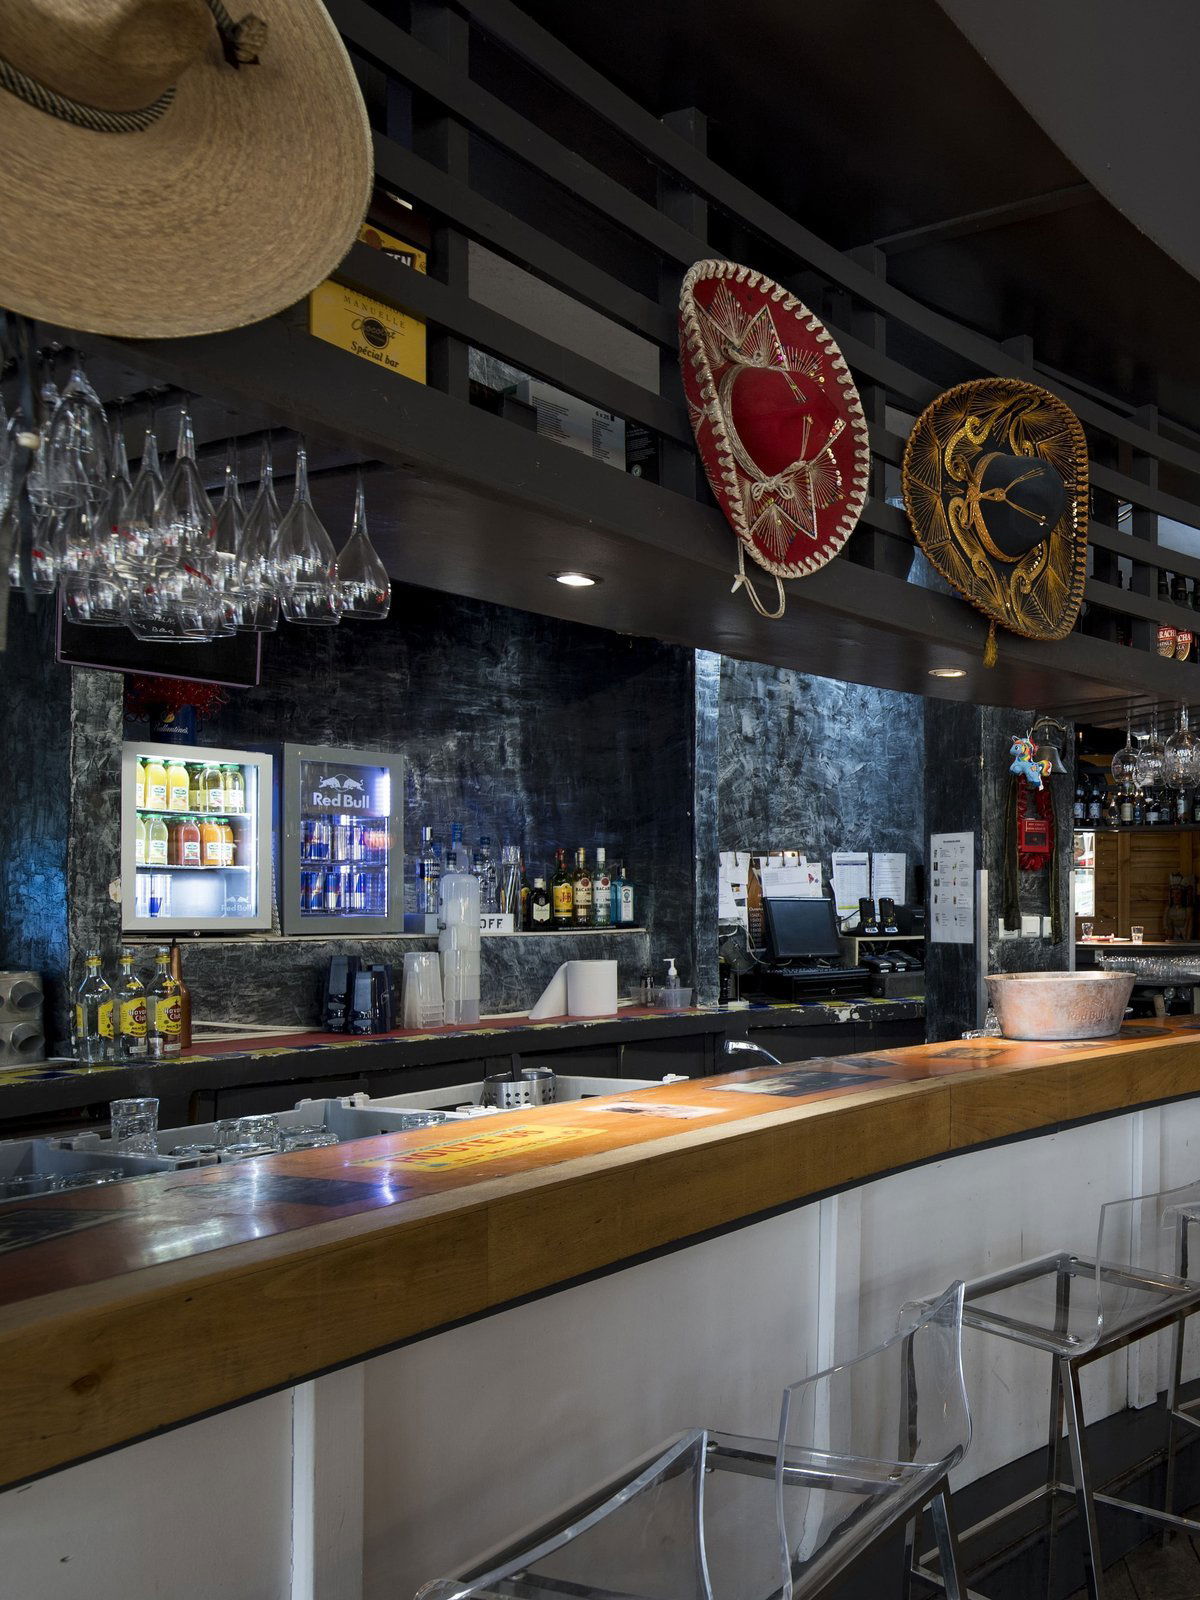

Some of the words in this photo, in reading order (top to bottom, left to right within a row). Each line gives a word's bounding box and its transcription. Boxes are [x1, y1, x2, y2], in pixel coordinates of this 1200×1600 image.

[351, 341, 383, 362] Spécial
[385, 355, 400, 368] bar
[313, 792, 342, 807] Red
[344, 795, 370, 809] Bull
